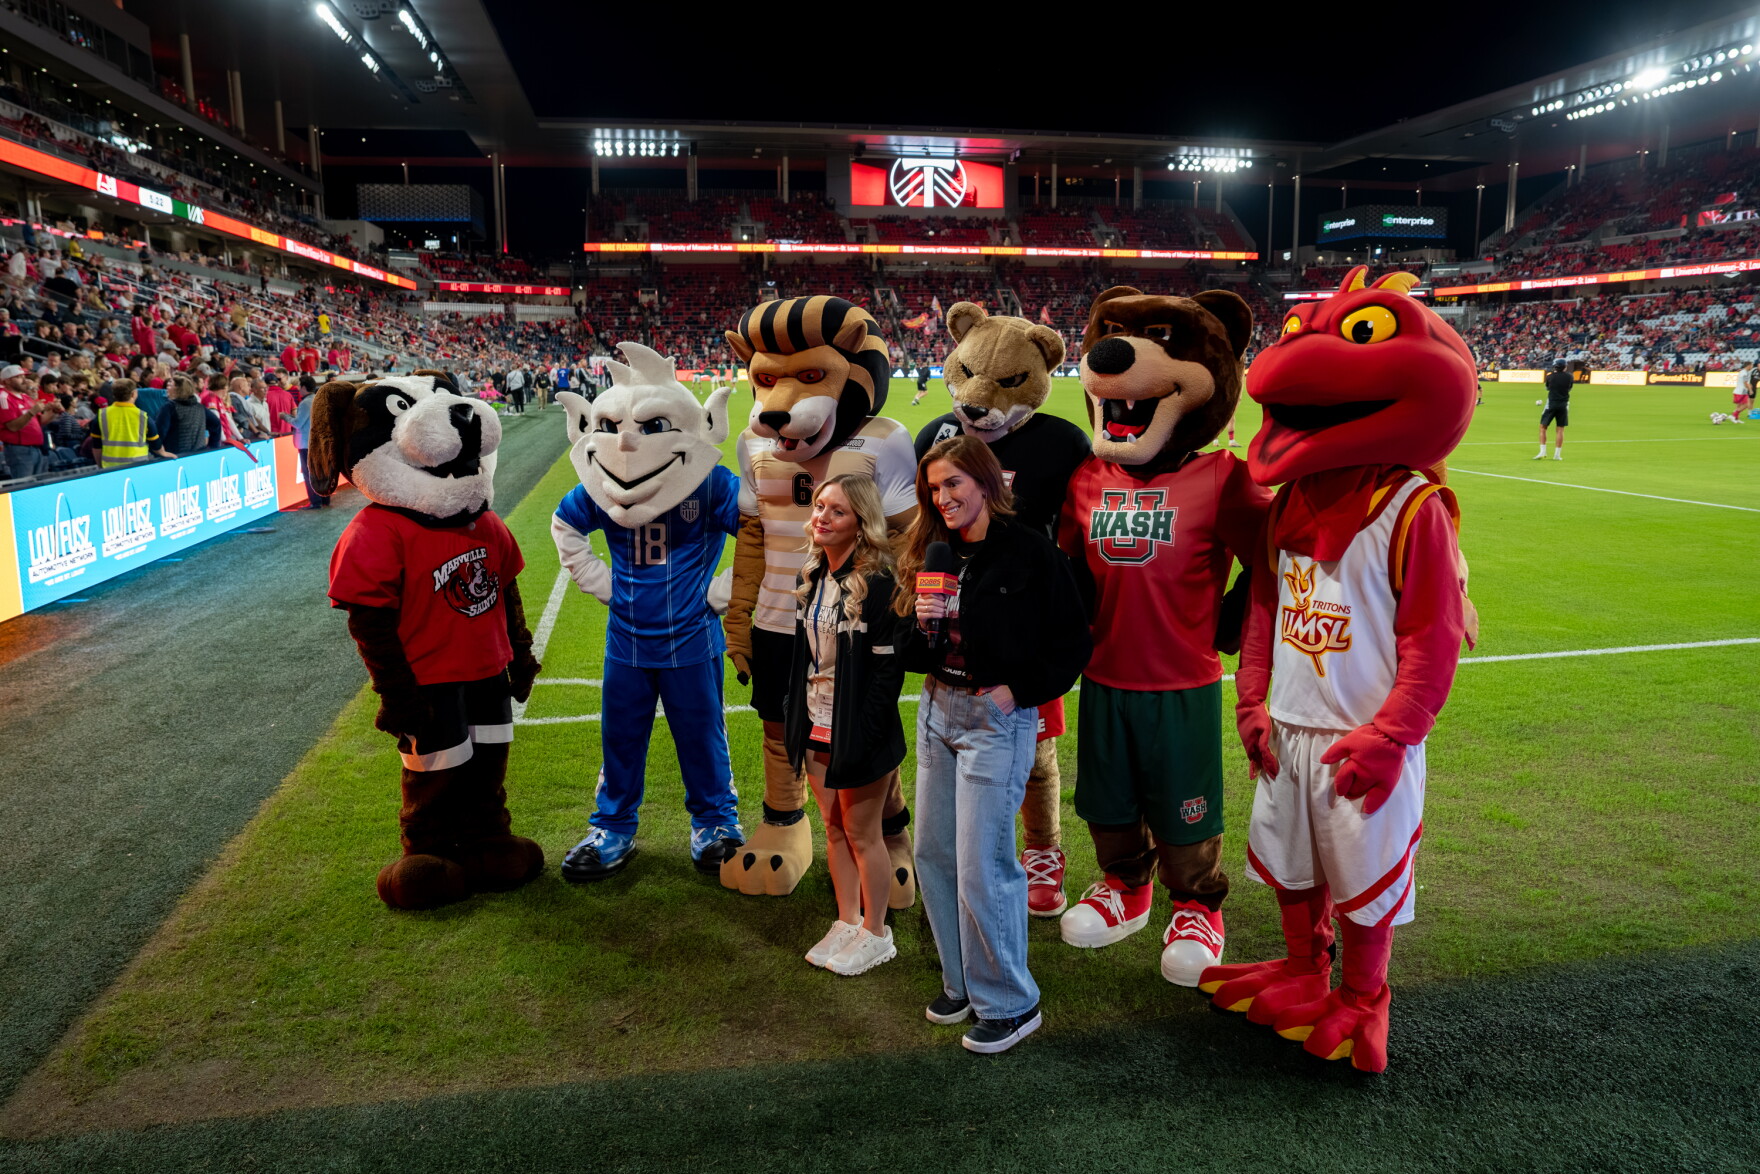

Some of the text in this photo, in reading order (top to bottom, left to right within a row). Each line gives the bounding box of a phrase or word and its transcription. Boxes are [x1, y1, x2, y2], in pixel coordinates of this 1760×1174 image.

[1324, 218, 1355, 230] enterprise
[1383, 216, 1434, 226] enterprise
[1676, 267, 1702, 276] University
[1687, 374, 1702, 382] Tire
[206, 474, 240, 507] LOU FUSZ
[244, 469, 256, 496] LOU
[258, 465, 272, 492] FUSZ
[792, 472, 814, 507] 6
[160, 484, 201, 524] LOU FUSZ
[682, 502, 697, 510] SLU
[102, 498, 152, 543] LOU FUSZ
[1090, 510, 1175, 544] WASH
[28, 514, 92, 566] LOU FUSZ
[635, 522, 667, 565] 18
[433, 548, 486, 592] MARYVILLE
[469, 588, 497, 617] SAINTS
[1312, 600, 1351, 614] TRITONS
[1283, 610, 1350, 652] UMSL
[1182, 803, 1206, 817] WASH
